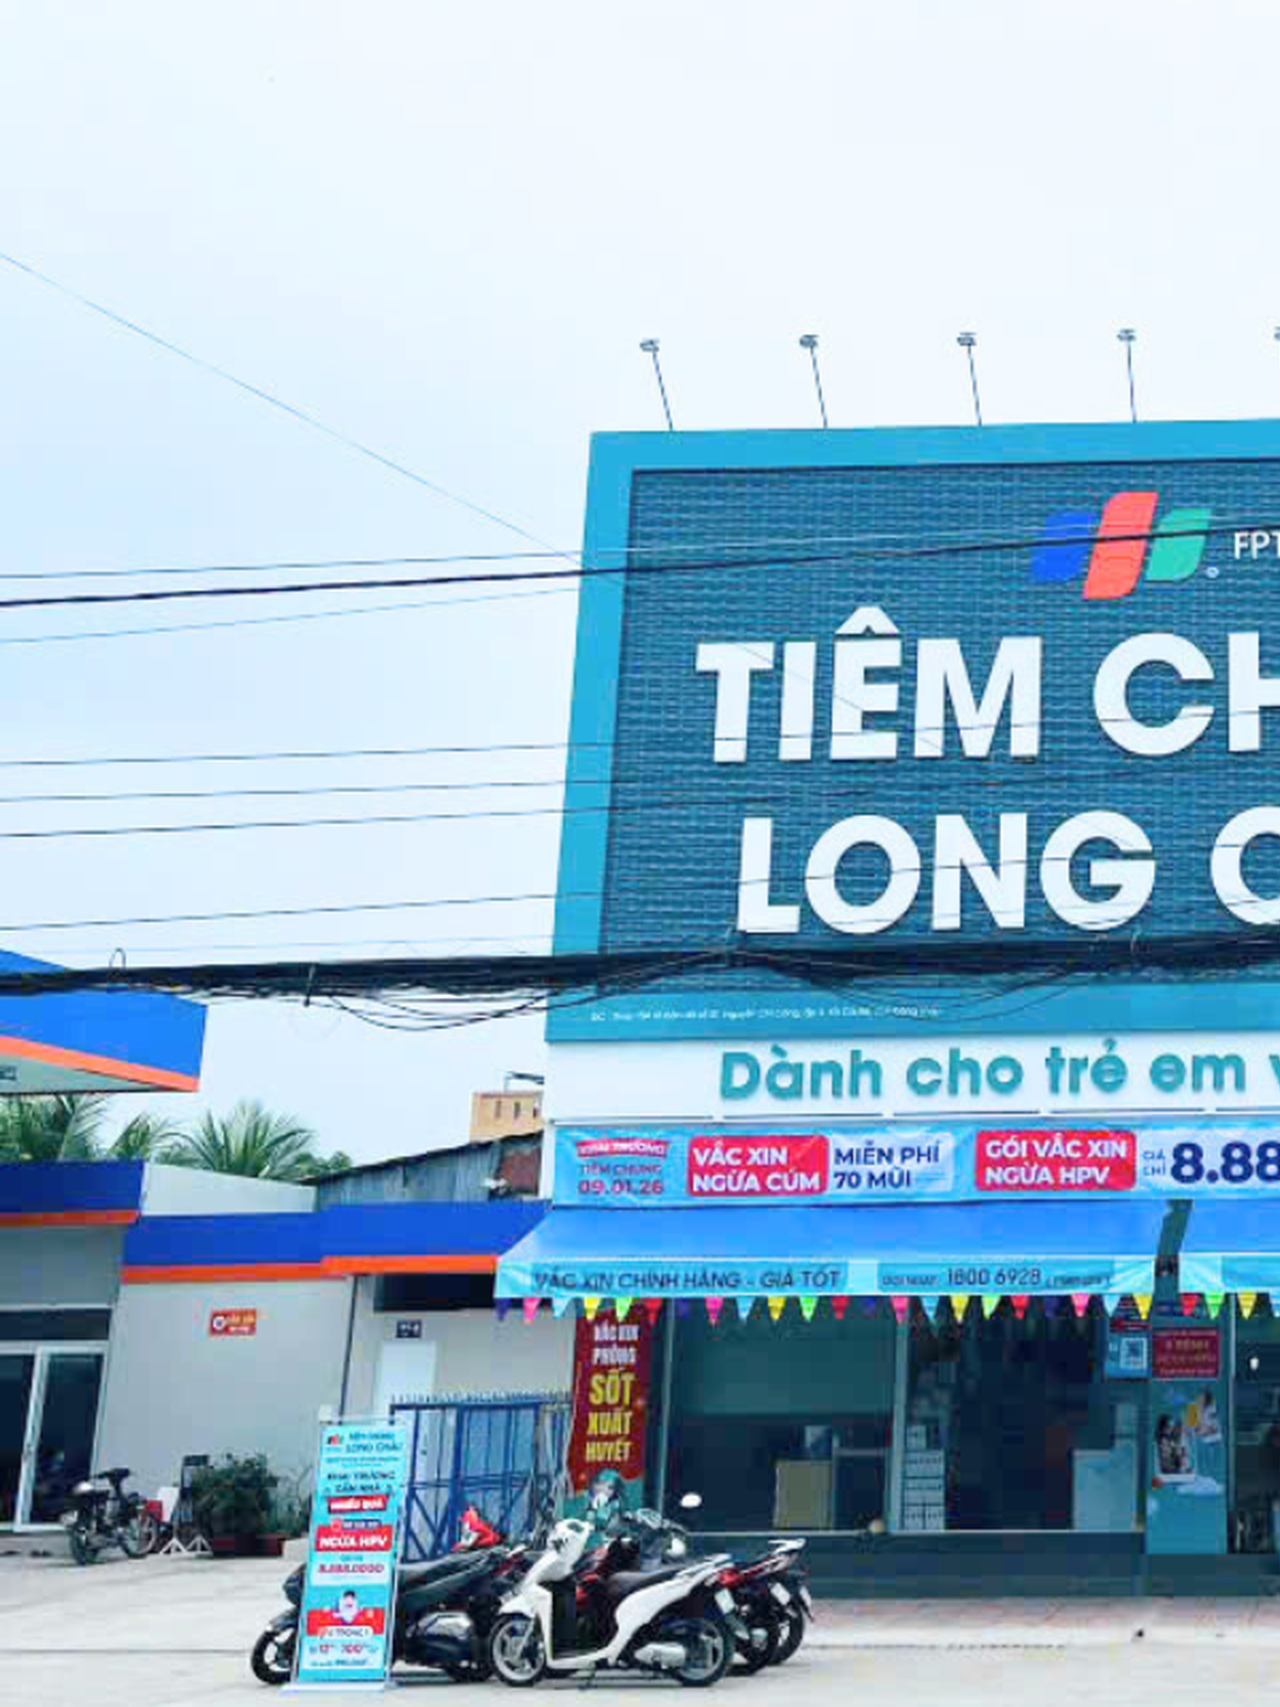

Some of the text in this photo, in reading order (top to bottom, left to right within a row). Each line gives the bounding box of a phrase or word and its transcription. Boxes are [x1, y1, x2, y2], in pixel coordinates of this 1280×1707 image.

[694, 606, 1043, 764] TIÊM
[736, 810, 1157, 935] LONG
[719, 1043, 884, 1099] Dành
[905, 1046, 1025, 1097] cho
[1045, 1036, 1129, 1095] trẻ
[1148, 1052, 1247, 1093] em
[745, 1147, 788, 1166] XIN
[834, 1139, 941, 1166] MIỄN PHÍ
[985, 1134, 1031, 1159] GÓI
[1087, 1138, 1128, 1158] XIN
[691, 1168, 821, 1193] NGỪA CÚM
[834, 1168, 912, 1190] 70 MŨI
[985, 1161, 1110, 1184] NGỪA HPV
[948, 1267, 990, 1286] 1800
[994, 1267, 1042, 1286] 6928
[589, 1368, 634, 1405] SỐT
